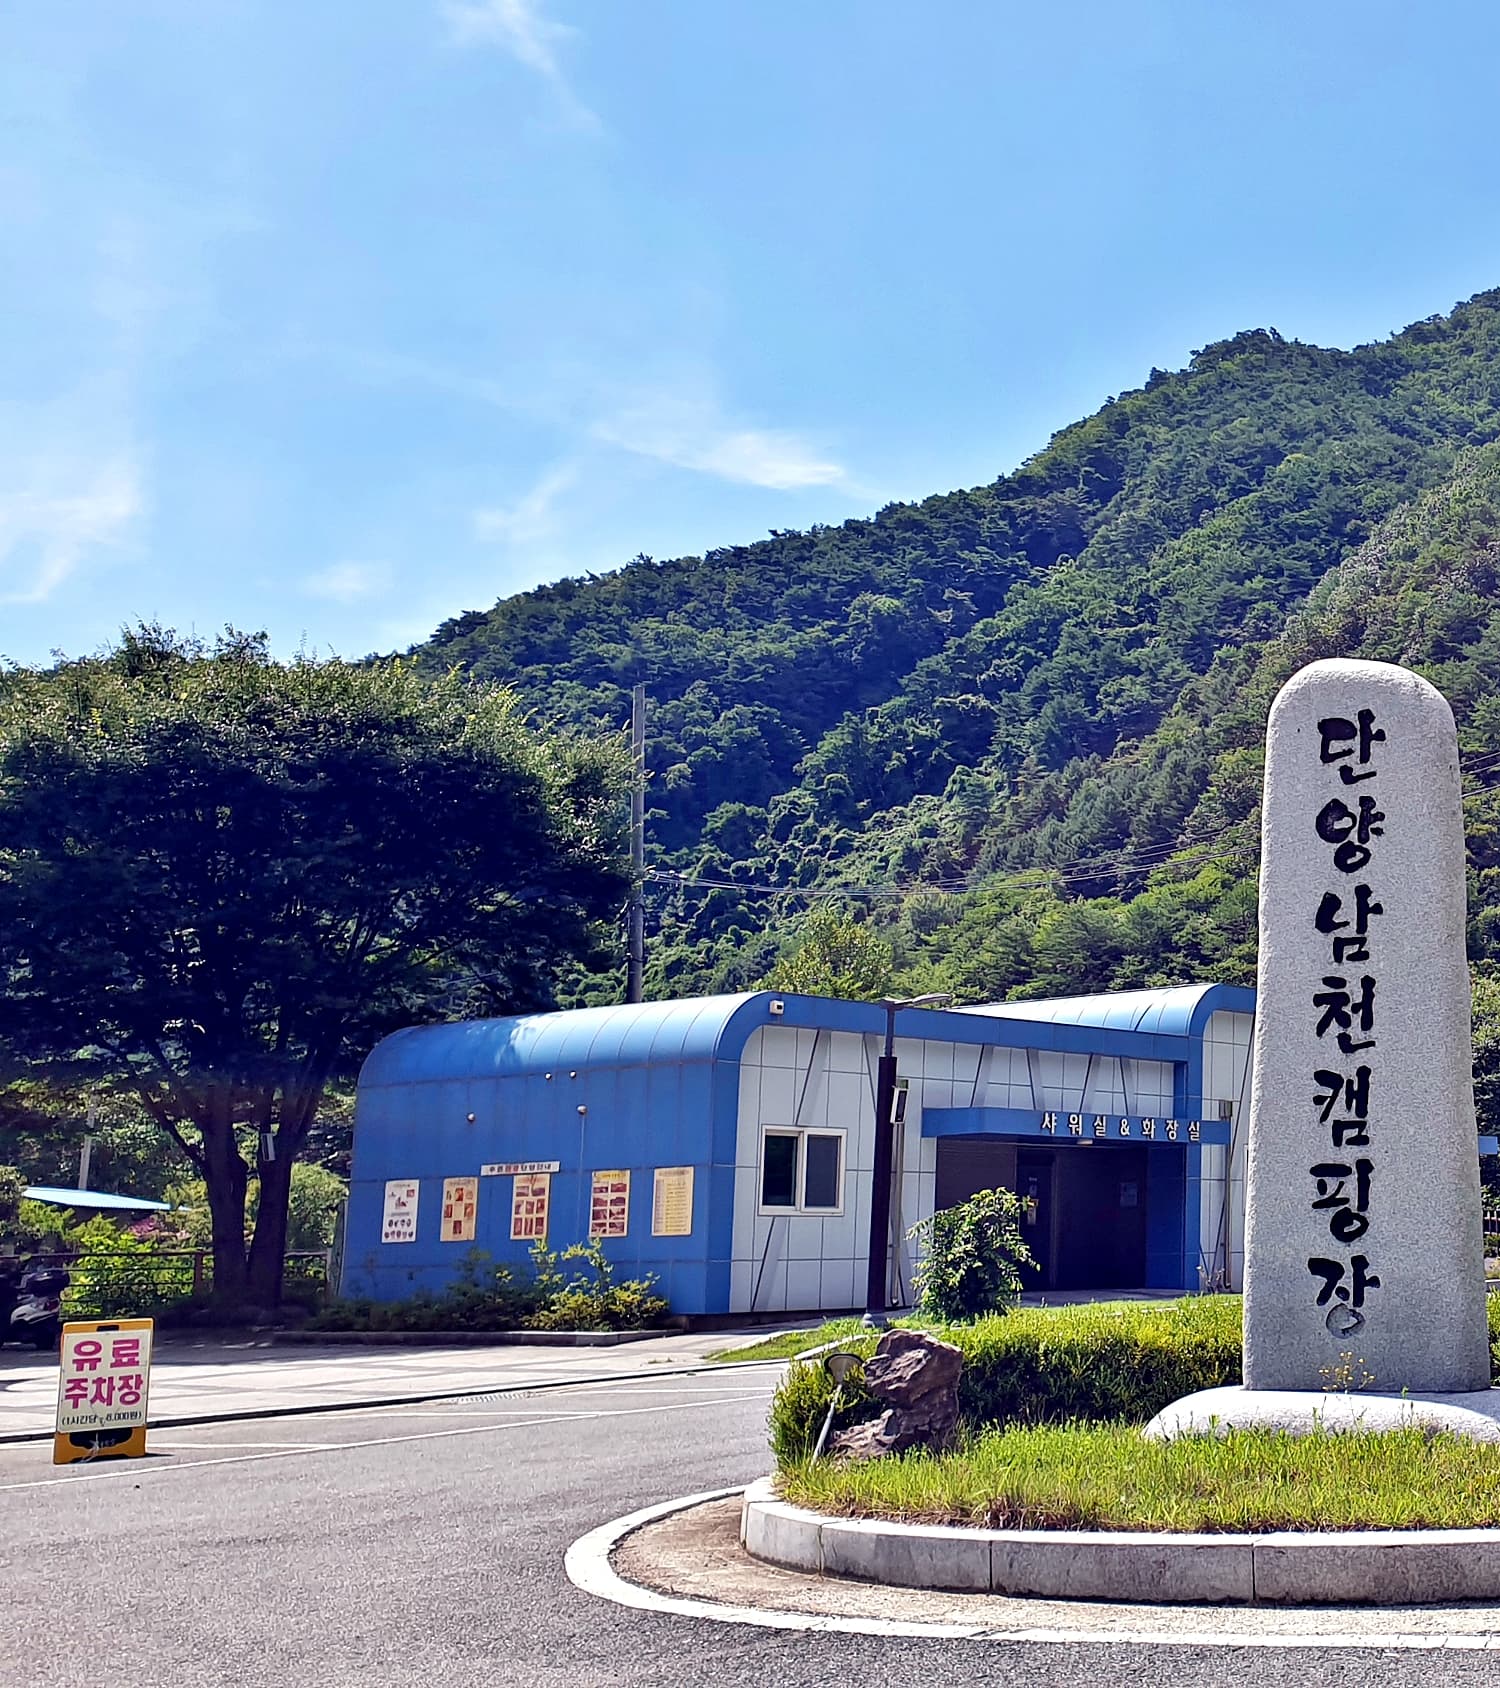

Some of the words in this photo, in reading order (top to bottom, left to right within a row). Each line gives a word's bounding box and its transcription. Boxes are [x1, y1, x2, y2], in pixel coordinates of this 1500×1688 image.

[1307, 708, 1386, 1338] 단양남천캠핑장
[1041, 1112, 1107, 1137] 샤워실
[1120, 1118, 1131, 1136] &
[1142, 1118, 1200, 1141] 화장실
[72, 1339, 140, 1372] 유료
[65, 1374, 143, 1409] 주차장
